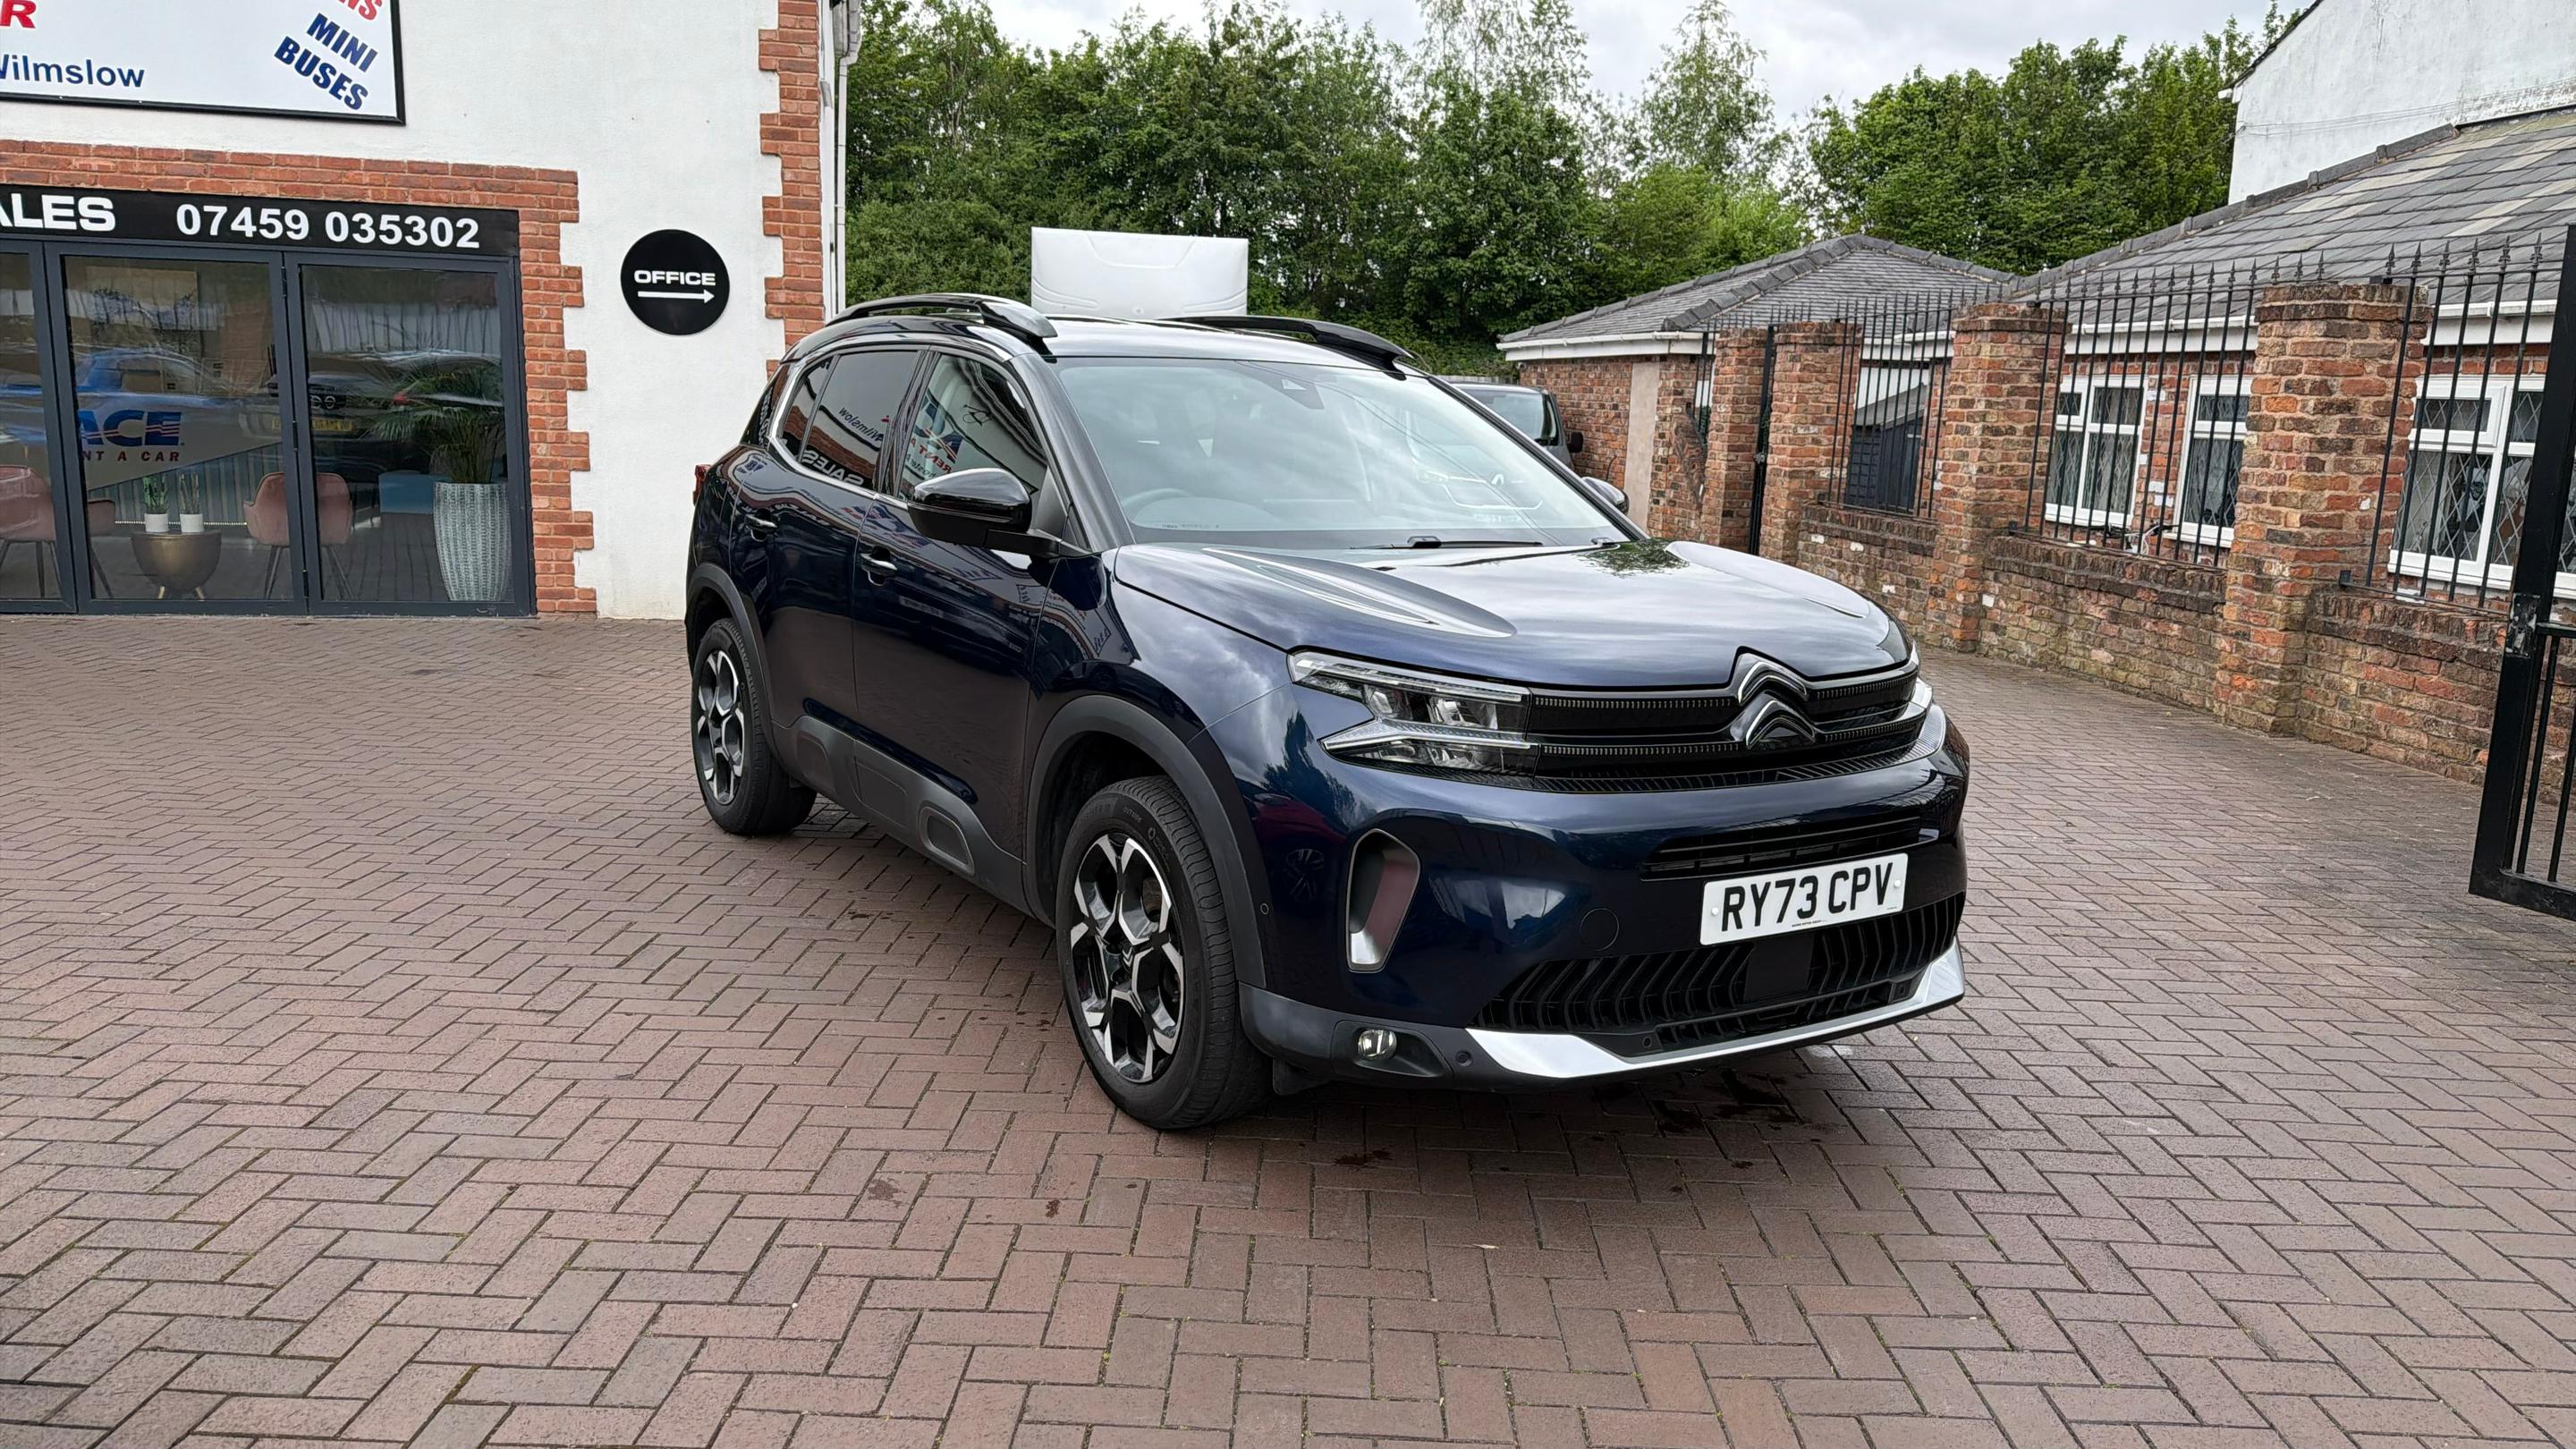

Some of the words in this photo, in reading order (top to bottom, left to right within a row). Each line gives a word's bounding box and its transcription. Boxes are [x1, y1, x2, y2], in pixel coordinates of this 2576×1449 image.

[306, 13, 378, 72] MINI
[274, 36, 369, 110] BUSES
[176, 203, 309, 241] 07459
[325, 211, 480, 249] 035302
[633, 269, 716, 286] OFFICE
[117, 451, 127, 462] A
[140, 451, 180, 462] CAR
[1721, 875, 1819, 932] RY73
[1827, 862, 1894, 915] CPV
